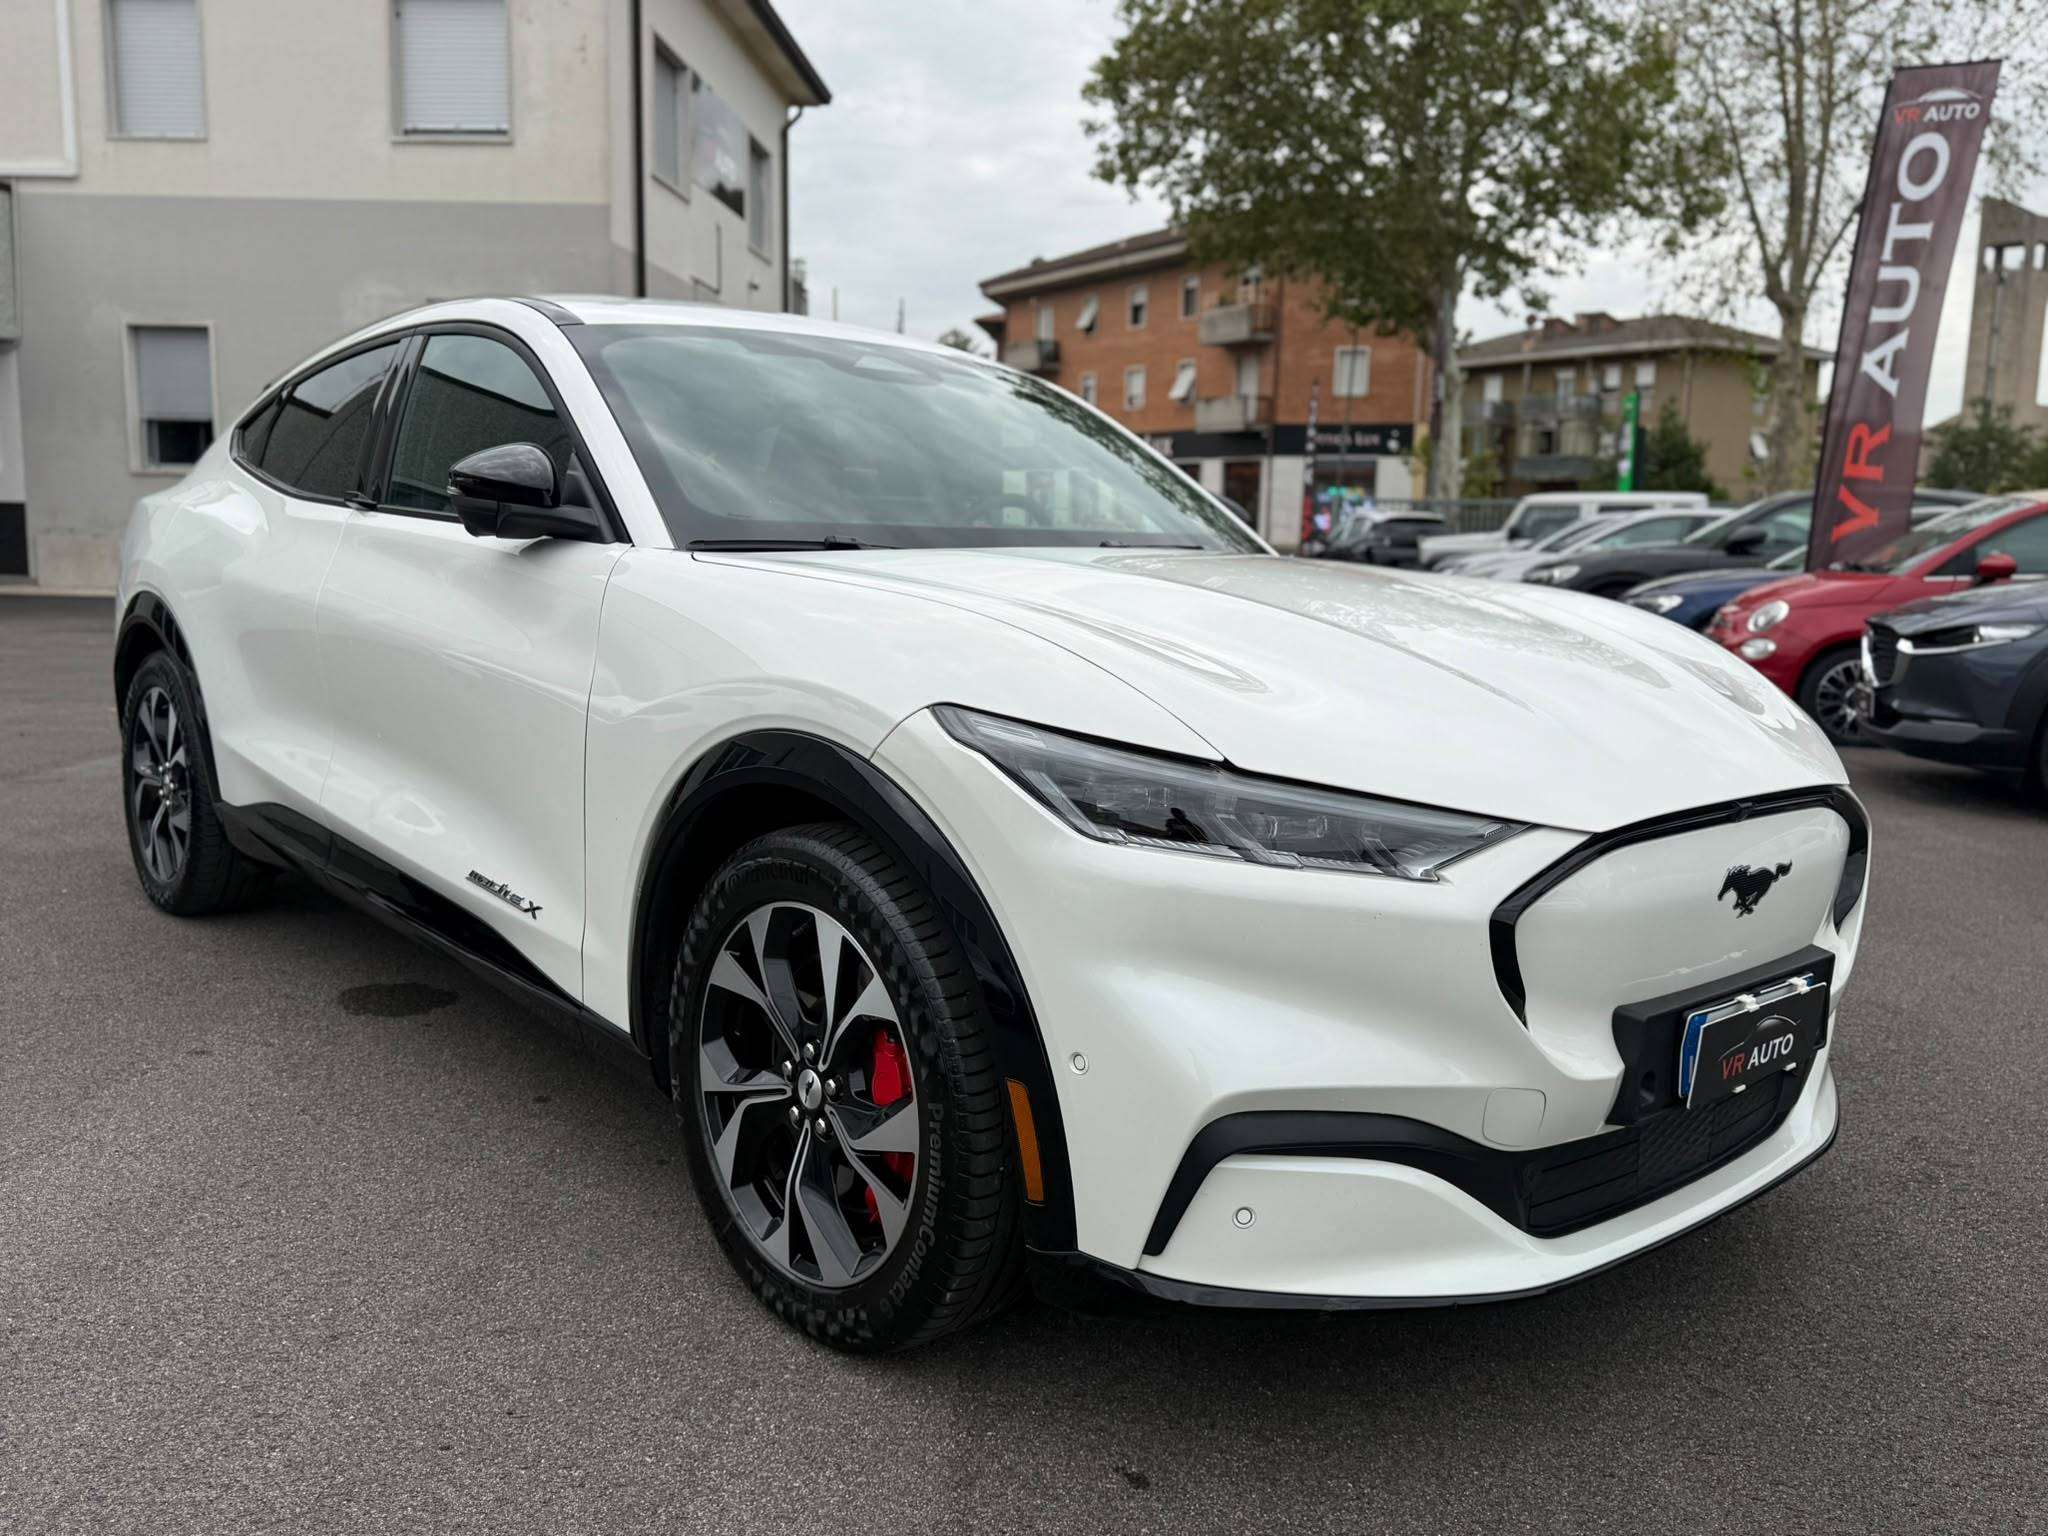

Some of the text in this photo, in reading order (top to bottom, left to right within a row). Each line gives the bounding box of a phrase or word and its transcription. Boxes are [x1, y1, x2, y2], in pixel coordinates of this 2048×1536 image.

[1893, 102, 1981, 126] VR AUTO
[1829, 131, 1951, 544] VR AUTO
[1721, 1032, 1795, 1081] VR AUTO
[889, 1102, 945, 1307] PremiumContact
